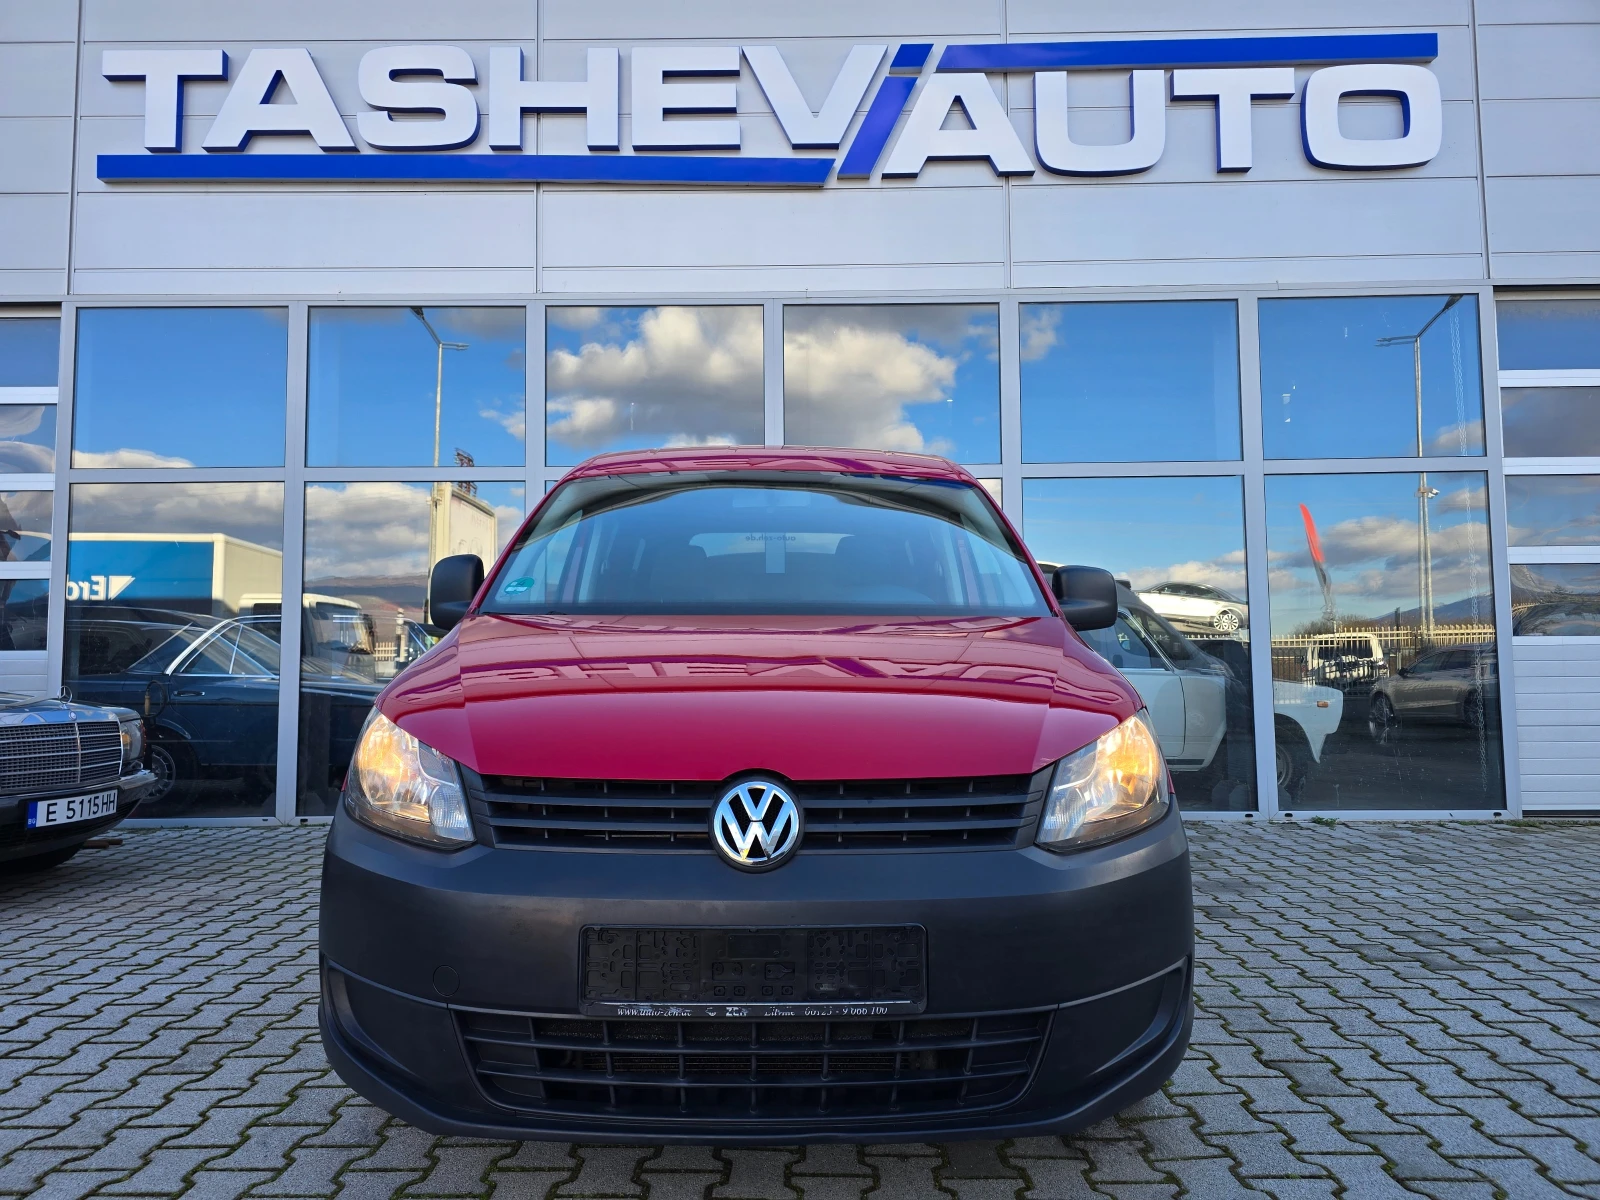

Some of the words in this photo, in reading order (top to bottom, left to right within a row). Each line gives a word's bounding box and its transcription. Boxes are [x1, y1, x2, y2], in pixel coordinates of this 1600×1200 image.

[101, 44, 888, 153] TASHEV
[881, 63, 1443, 178] AUTO
[45, 802, 58, 823] E
[714, 781, 799, 866] VW
